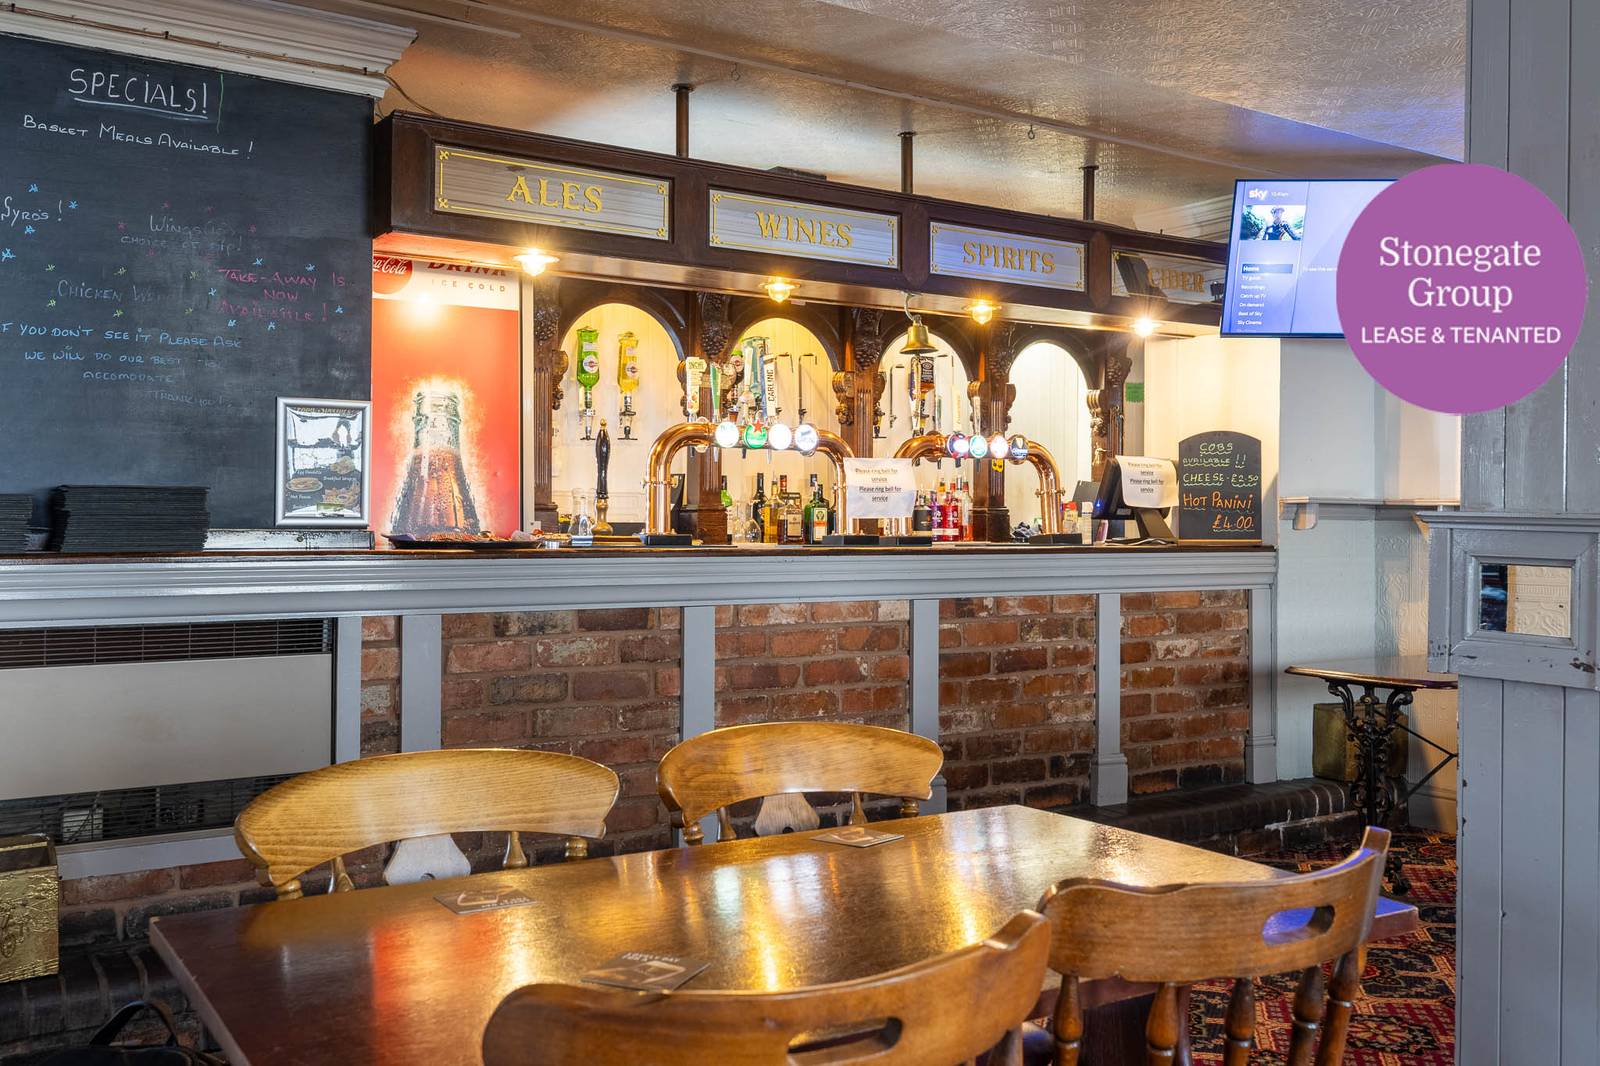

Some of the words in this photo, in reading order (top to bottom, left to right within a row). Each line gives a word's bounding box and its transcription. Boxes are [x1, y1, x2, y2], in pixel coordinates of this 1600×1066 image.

[23, 115, 89, 137] BASKET
[100, 123, 153, 145] MEALS
[505, 174, 604, 213] ALES
[755, 209, 854, 249] WINES
[962, 240, 1056, 275] SPIRITS
[468, 282, 505, 292] COLD
[20, 323, 47, 336] YOU
[104, 330, 130, 340] SEE
[159, 332, 209, 346] PLEASE
[213, 336, 241, 348] ASK
[24, 350, 46, 361] WE
[95, 351, 112, 362] DO
[120, 355, 145, 364] OUR
[1199, 442, 1233, 451] COBS
[1183, 472, 1225, 483] CHEESE
[1183, 492, 1208, 507] HOT
